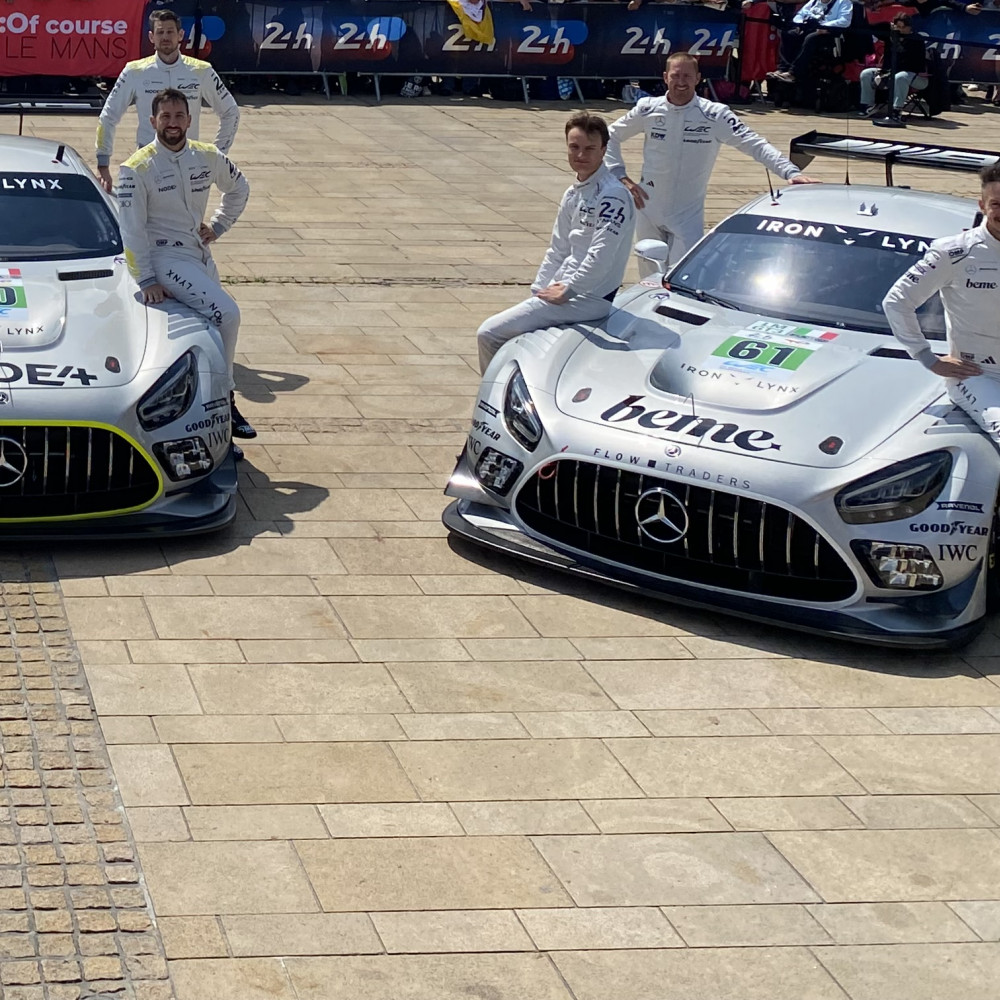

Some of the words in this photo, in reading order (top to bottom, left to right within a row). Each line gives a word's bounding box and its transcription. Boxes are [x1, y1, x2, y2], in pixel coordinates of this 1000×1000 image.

[45, 18, 128, 35] course
[260, 21, 314, 50] 24h
[333, 22, 387, 50] 24h
[517, 25, 570, 54] 24h
[5, 36, 37, 59] LE
[51, 36, 128, 60] MANS
[620, 27, 672, 55] 24h
[2, 178, 63, 190] LYNX
[756, 219, 824, 238] IRON
[882, 236, 931, 252] LYN
[165, 269, 193, 290] LYNX
[7, 325, 44, 335] LYNX
[727, 340, 797, 367] 61
[680, 363, 723, 380] IRON
[756, 380, 800, 393] LYNX
[600, 394, 782, 452] beme
[208, 428, 230, 448] IWC
[593, 447, 642, 465] FLOW
[665, 463, 751, 489] TRADERS
[909, 521, 989, 536] GOODYEAR
[938, 544, 978, 562] IWC
